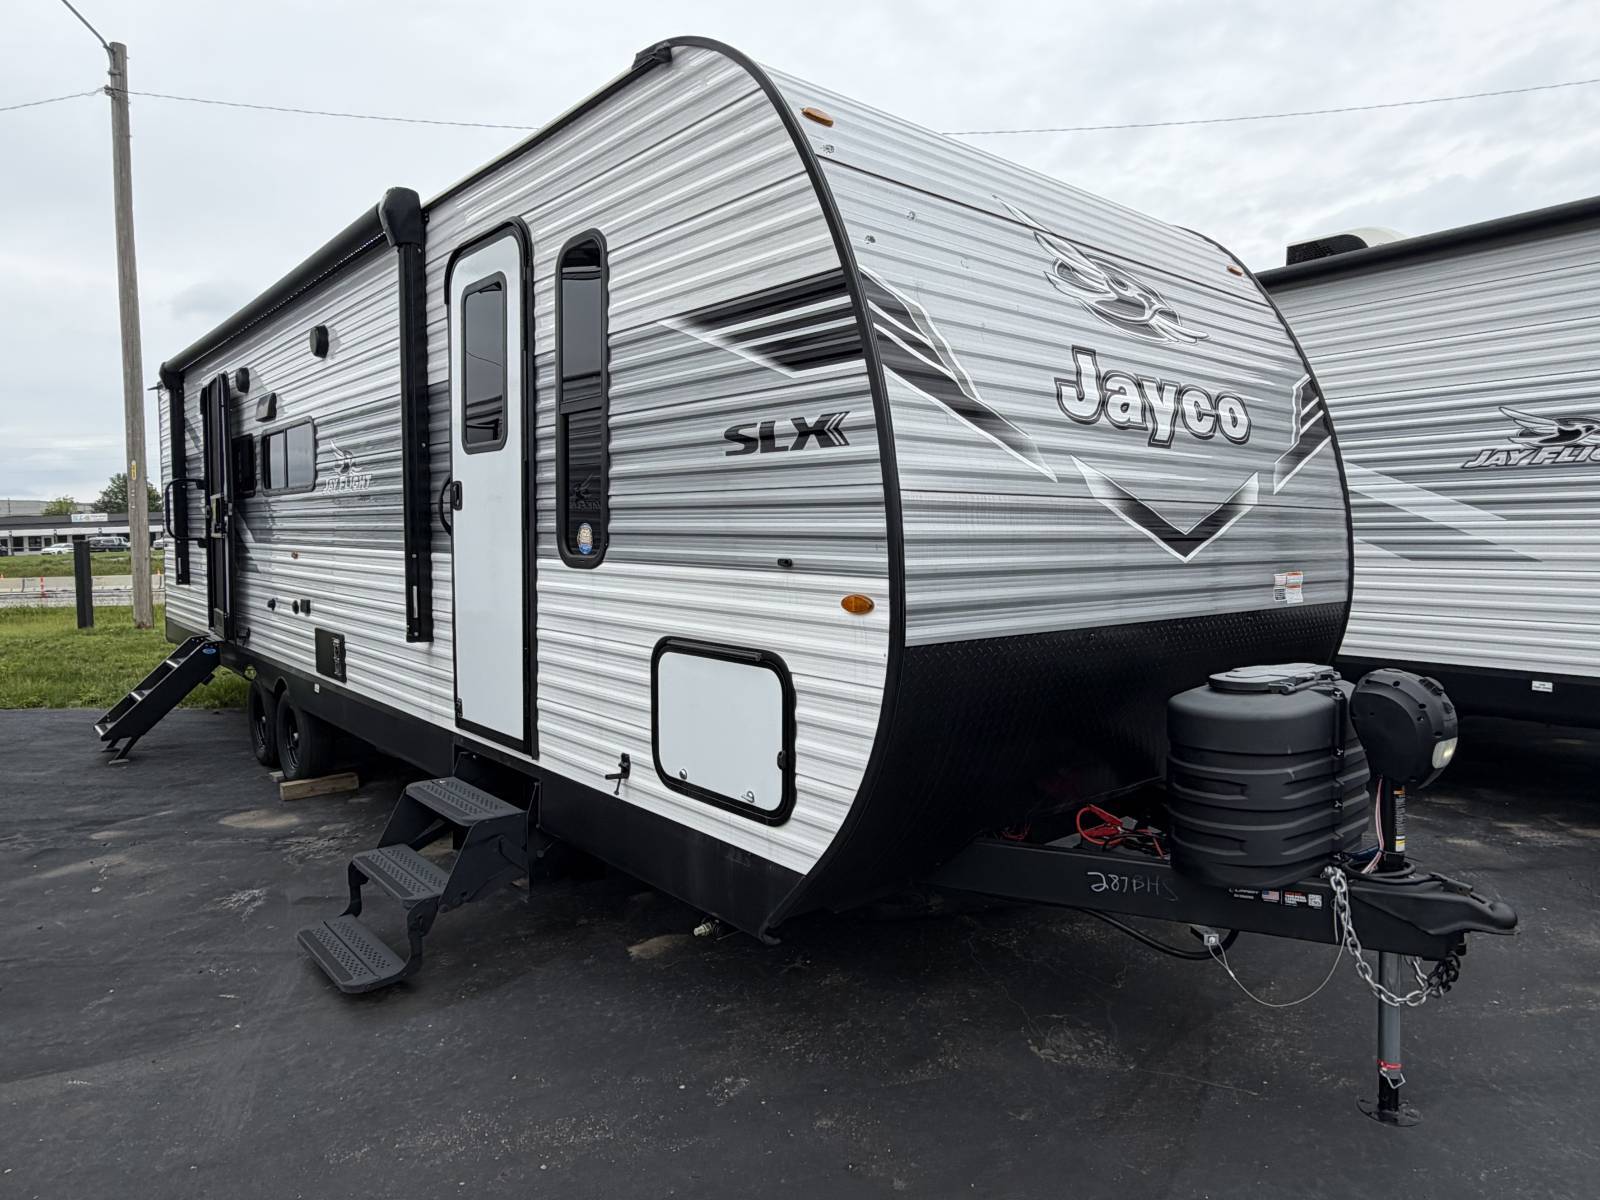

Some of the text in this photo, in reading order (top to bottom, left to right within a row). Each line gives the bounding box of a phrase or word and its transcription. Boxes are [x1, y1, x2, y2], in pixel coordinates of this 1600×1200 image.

[1054, 345, 1251, 448] Jayco
[724, 411, 850, 456] SLX
[1461, 448, 1537, 468] JAY
[322, 474, 372, 496] JAY FLIGHT
